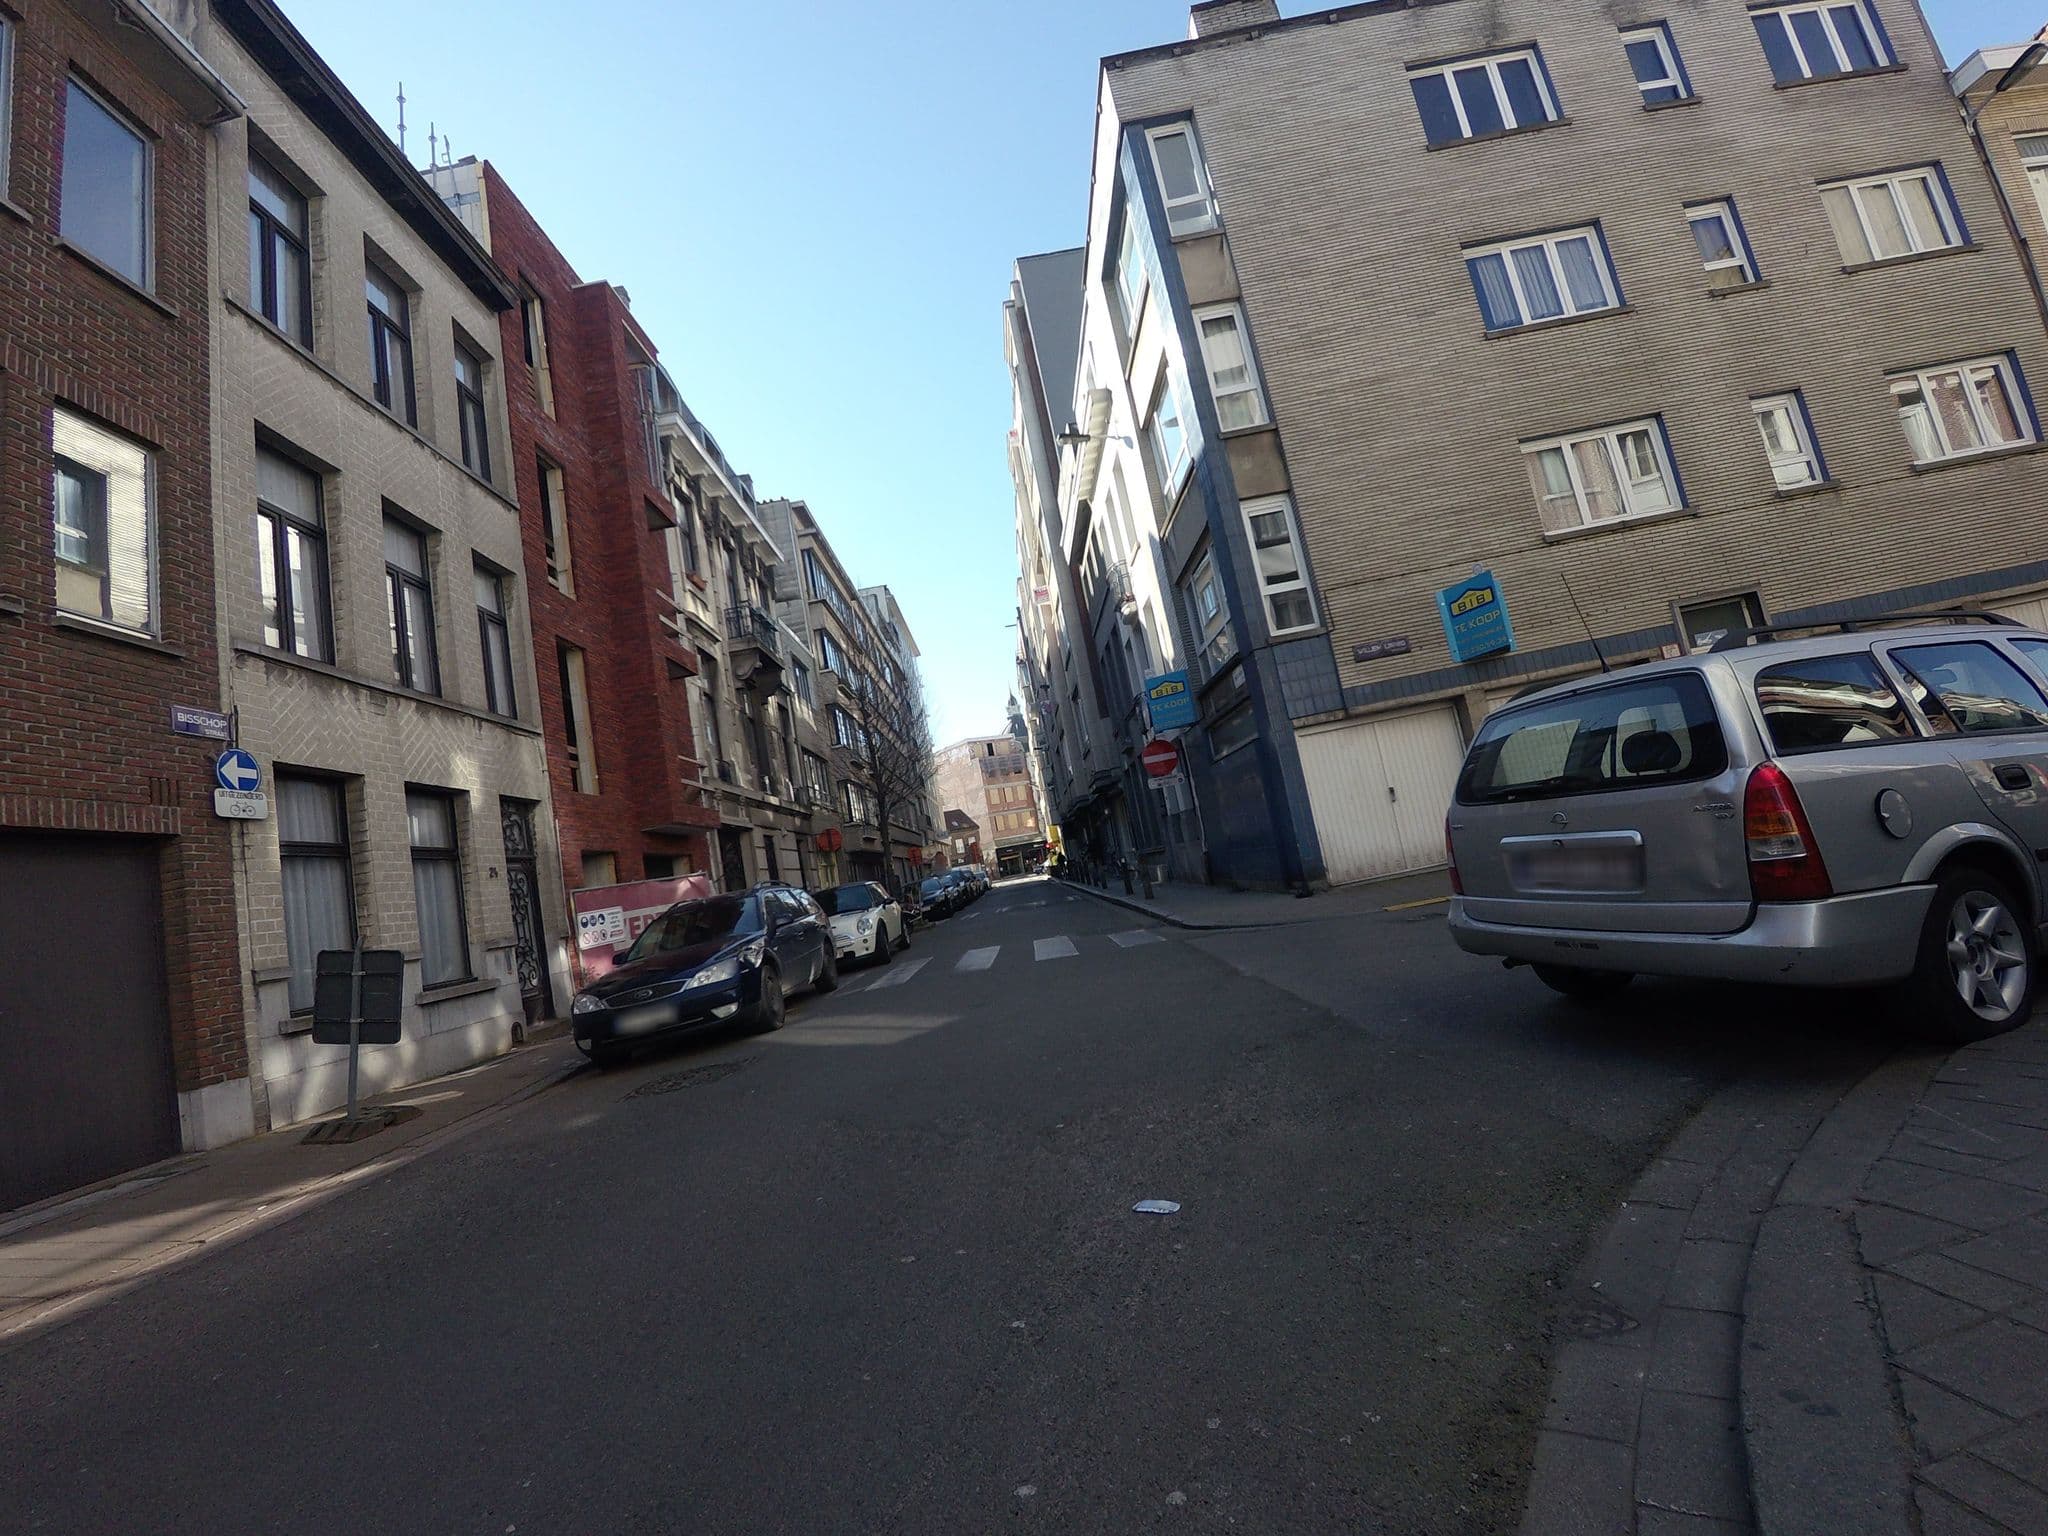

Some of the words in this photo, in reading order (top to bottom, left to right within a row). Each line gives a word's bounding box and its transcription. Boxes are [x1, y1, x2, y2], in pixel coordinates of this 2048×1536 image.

[1457, 594, 1485, 611] BIB
[1455, 623, 1467, 633] TE
[1470, 609, 1500, 629] KOOP
[1155, 685, 1178, 697] BIB
[177, 712, 227, 728] BISSCHOP
